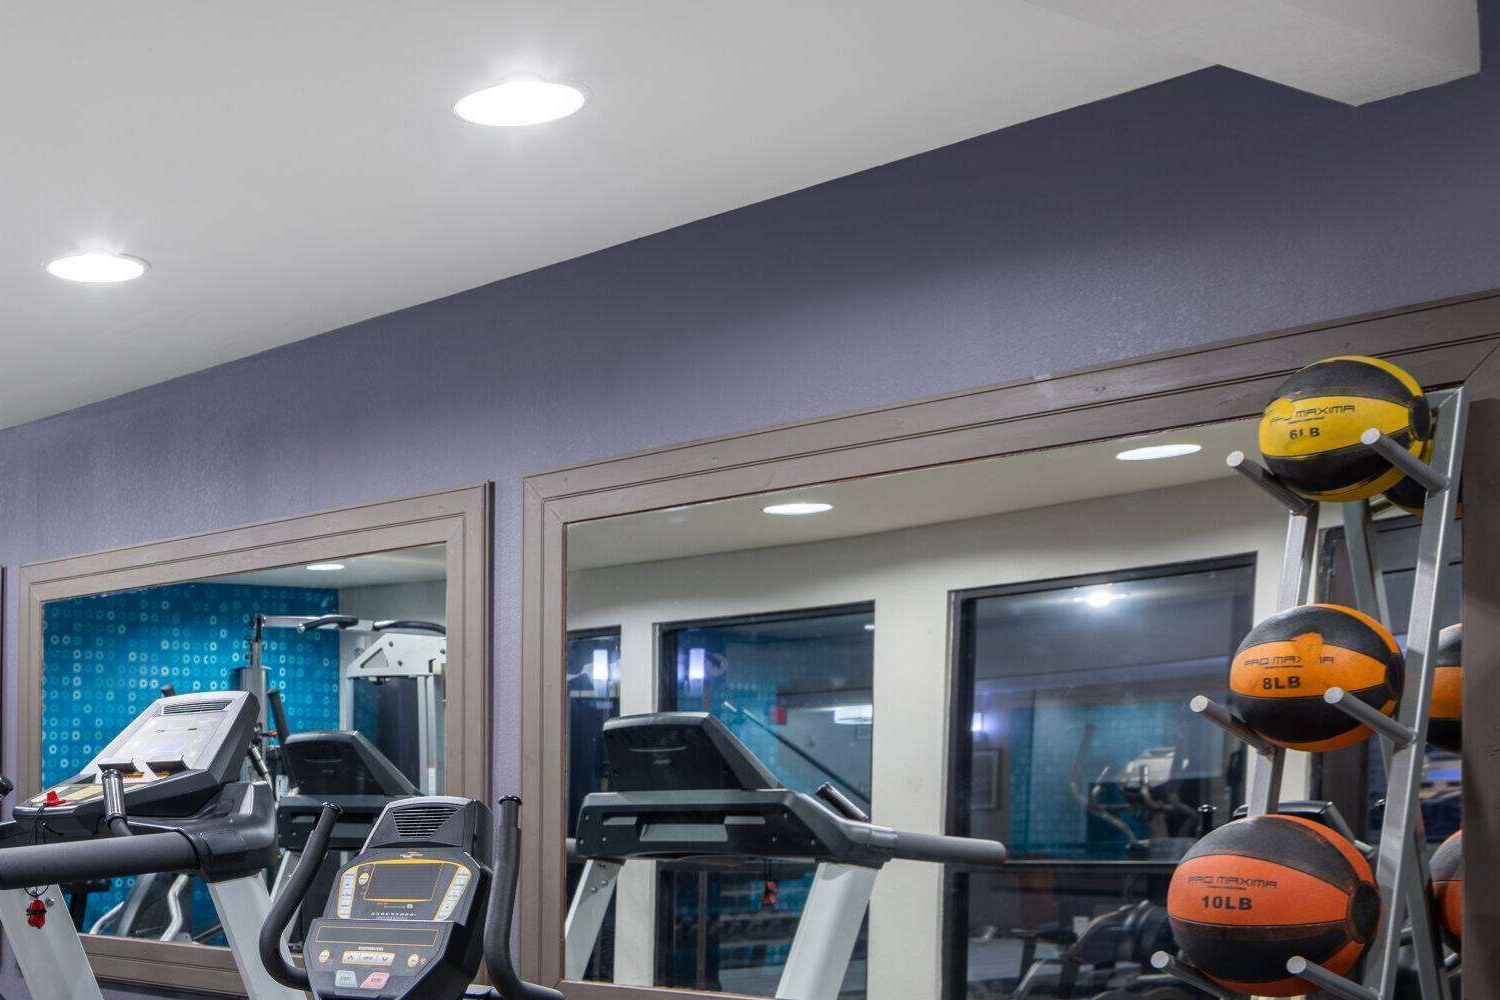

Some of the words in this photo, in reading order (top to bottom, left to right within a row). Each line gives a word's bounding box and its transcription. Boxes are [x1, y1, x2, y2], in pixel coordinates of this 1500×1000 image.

[1262, 676, 1300, 689] 8LB
[1187, 875, 1213, 884] PRO
[1218, 876, 1277, 889] MAXIMA
[1202, 895, 1252, 910] 10LB
